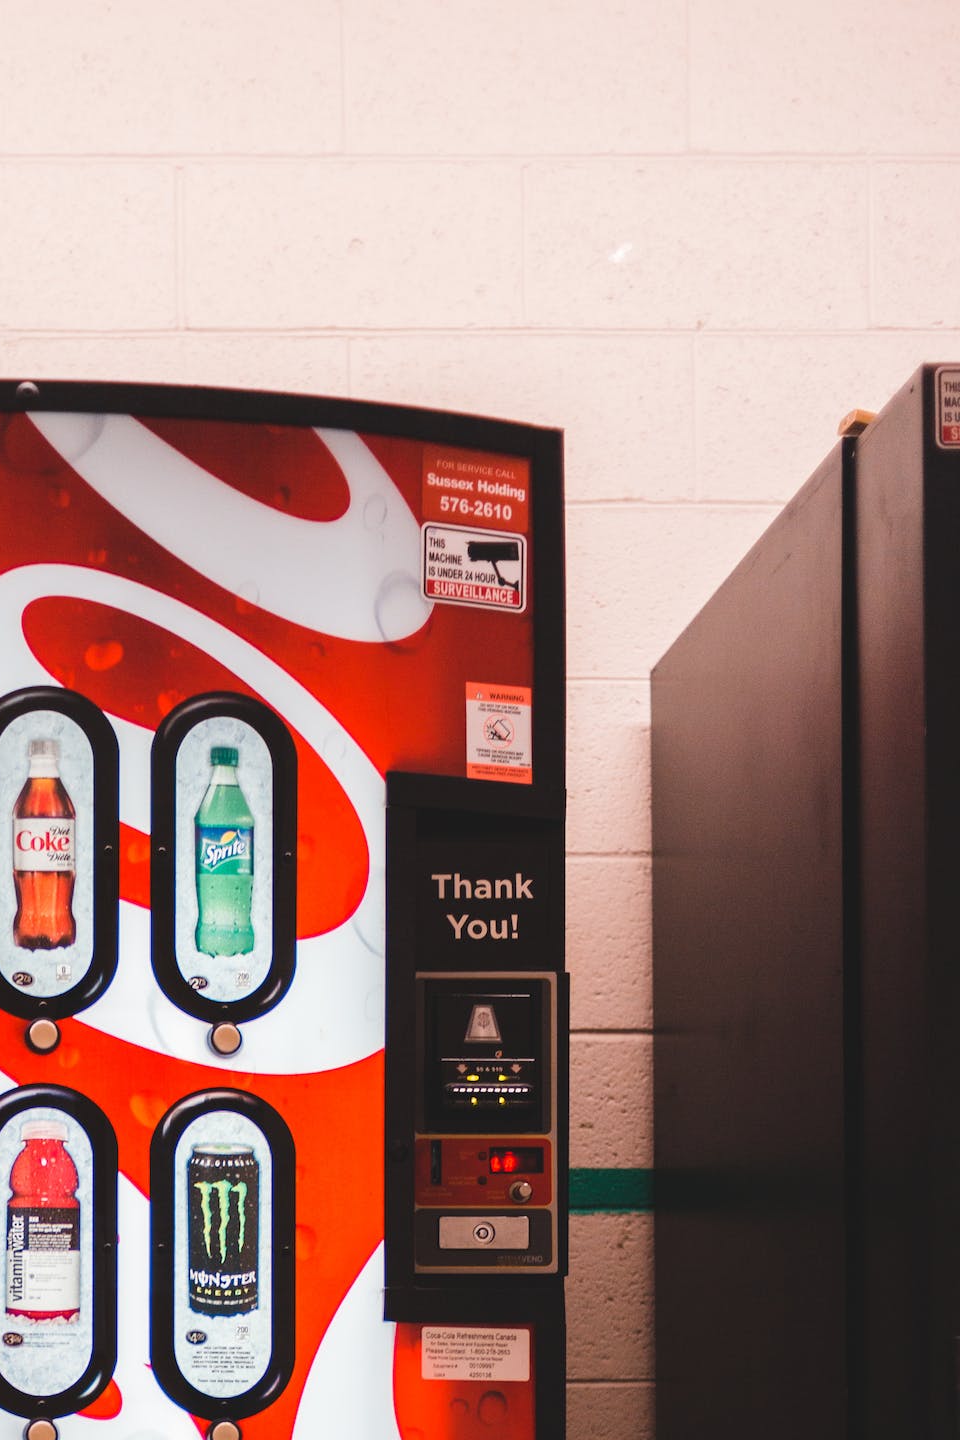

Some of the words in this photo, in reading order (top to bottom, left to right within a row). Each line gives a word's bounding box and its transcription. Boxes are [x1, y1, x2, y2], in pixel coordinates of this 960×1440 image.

[436, 460, 453, 470] FOR
[457, 462, 492, 476] SERVICE
[495, 467, 516, 479] CALL
[427, 473, 474, 491] Sussex
[477, 479, 526, 501] Holding
[440, 496, 512, 520] 576-2610
[429, 537, 446, 549] THIS
[429, 552, 462, 566] MACHINE
[428, 567, 436, 577] IS
[438, 568, 463, 580] UNDER
[465, 570, 473, 581] 24
[475, 572, 496, 584] HOUR
[434, 581, 514, 604] SURVEILLANCE
[490, 693, 524, 702] WARNING
[16, 830, 70, 851] Coke
[203, 840, 246, 866] Sprite
[431, 873, 534, 899] Thank
[446, 914, 519, 940] You!
[10, 1214, 24, 1302] vitaminwater
[190, 1268, 256, 1289] MONSTER
[196, 1286, 249, 1296] ENERGY
